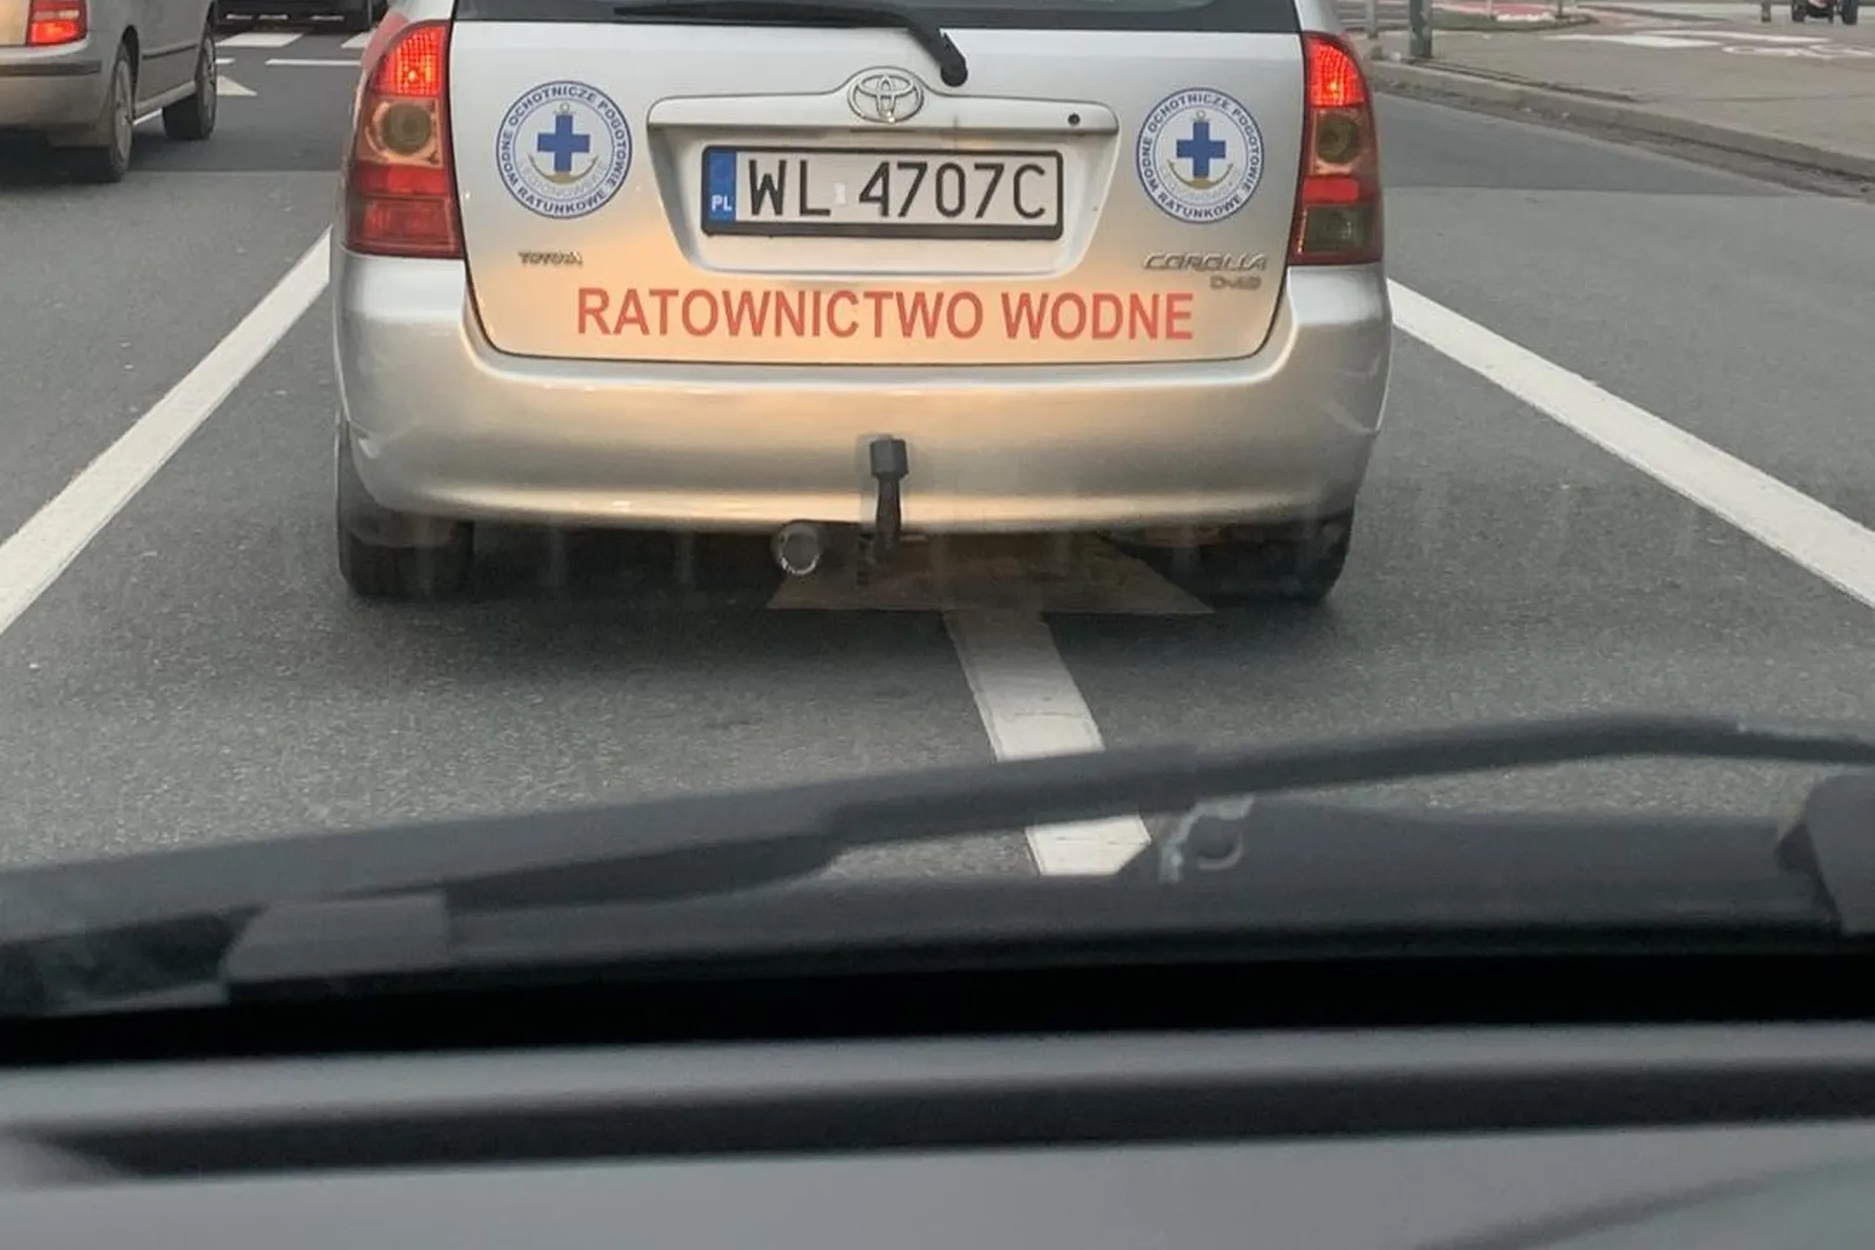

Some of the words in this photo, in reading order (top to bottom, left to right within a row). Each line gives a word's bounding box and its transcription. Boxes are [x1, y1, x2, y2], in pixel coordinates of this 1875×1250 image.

[508, 85, 596, 127] OCHOTNICZE
[516, 187, 607, 213] RATUNKOWE
[711, 195, 732, 212] PL
[748, 159, 831, 216] WL
[858, 161, 1046, 219] 4707C
[1157, 192, 1242, 219] RATUNKOWE
[1143, 251, 1266, 271] COROLLA
[577, 287, 984, 340] RATOWNICTWO
[1000, 292, 1194, 340] WODNE
